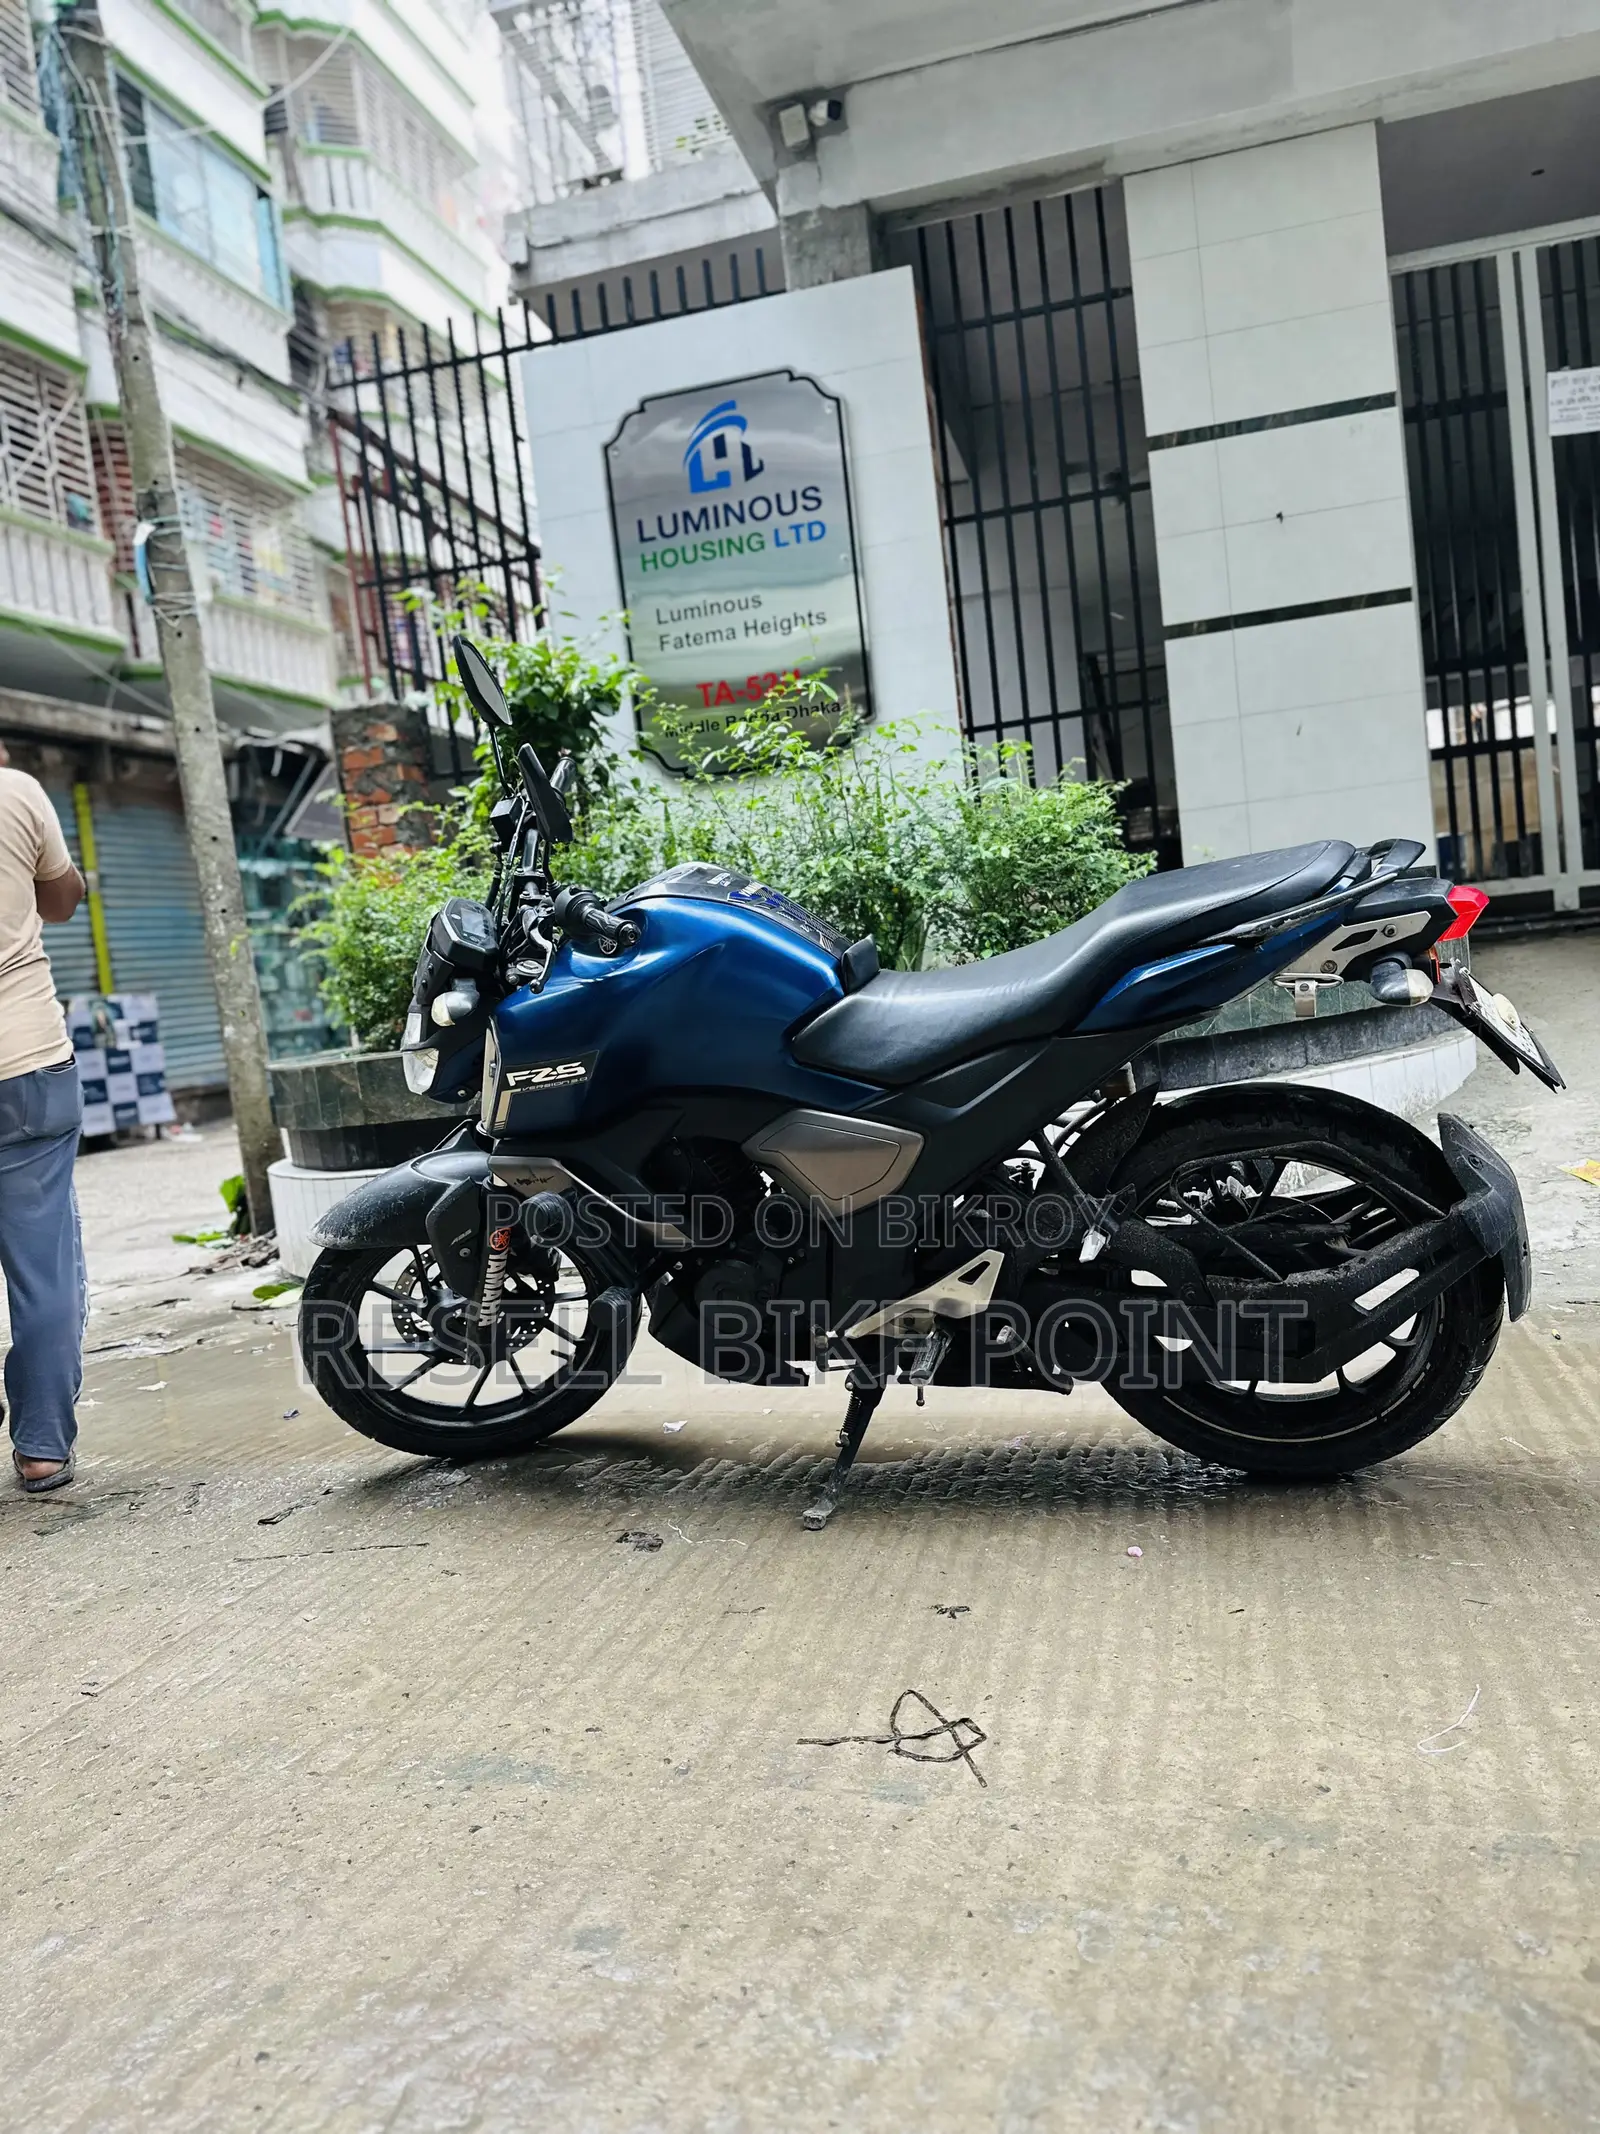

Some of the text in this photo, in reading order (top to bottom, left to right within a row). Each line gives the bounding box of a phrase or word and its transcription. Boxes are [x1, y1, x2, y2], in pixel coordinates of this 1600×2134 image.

[637, 485, 823, 544] LUMINOUS
[640, 520, 827, 573] HOUSING LTD
[656, 595, 763, 626] Luminous
[659, 610, 828, 653] Fatema Heights
[478, 1248, 508, 1327] YAMAHA
